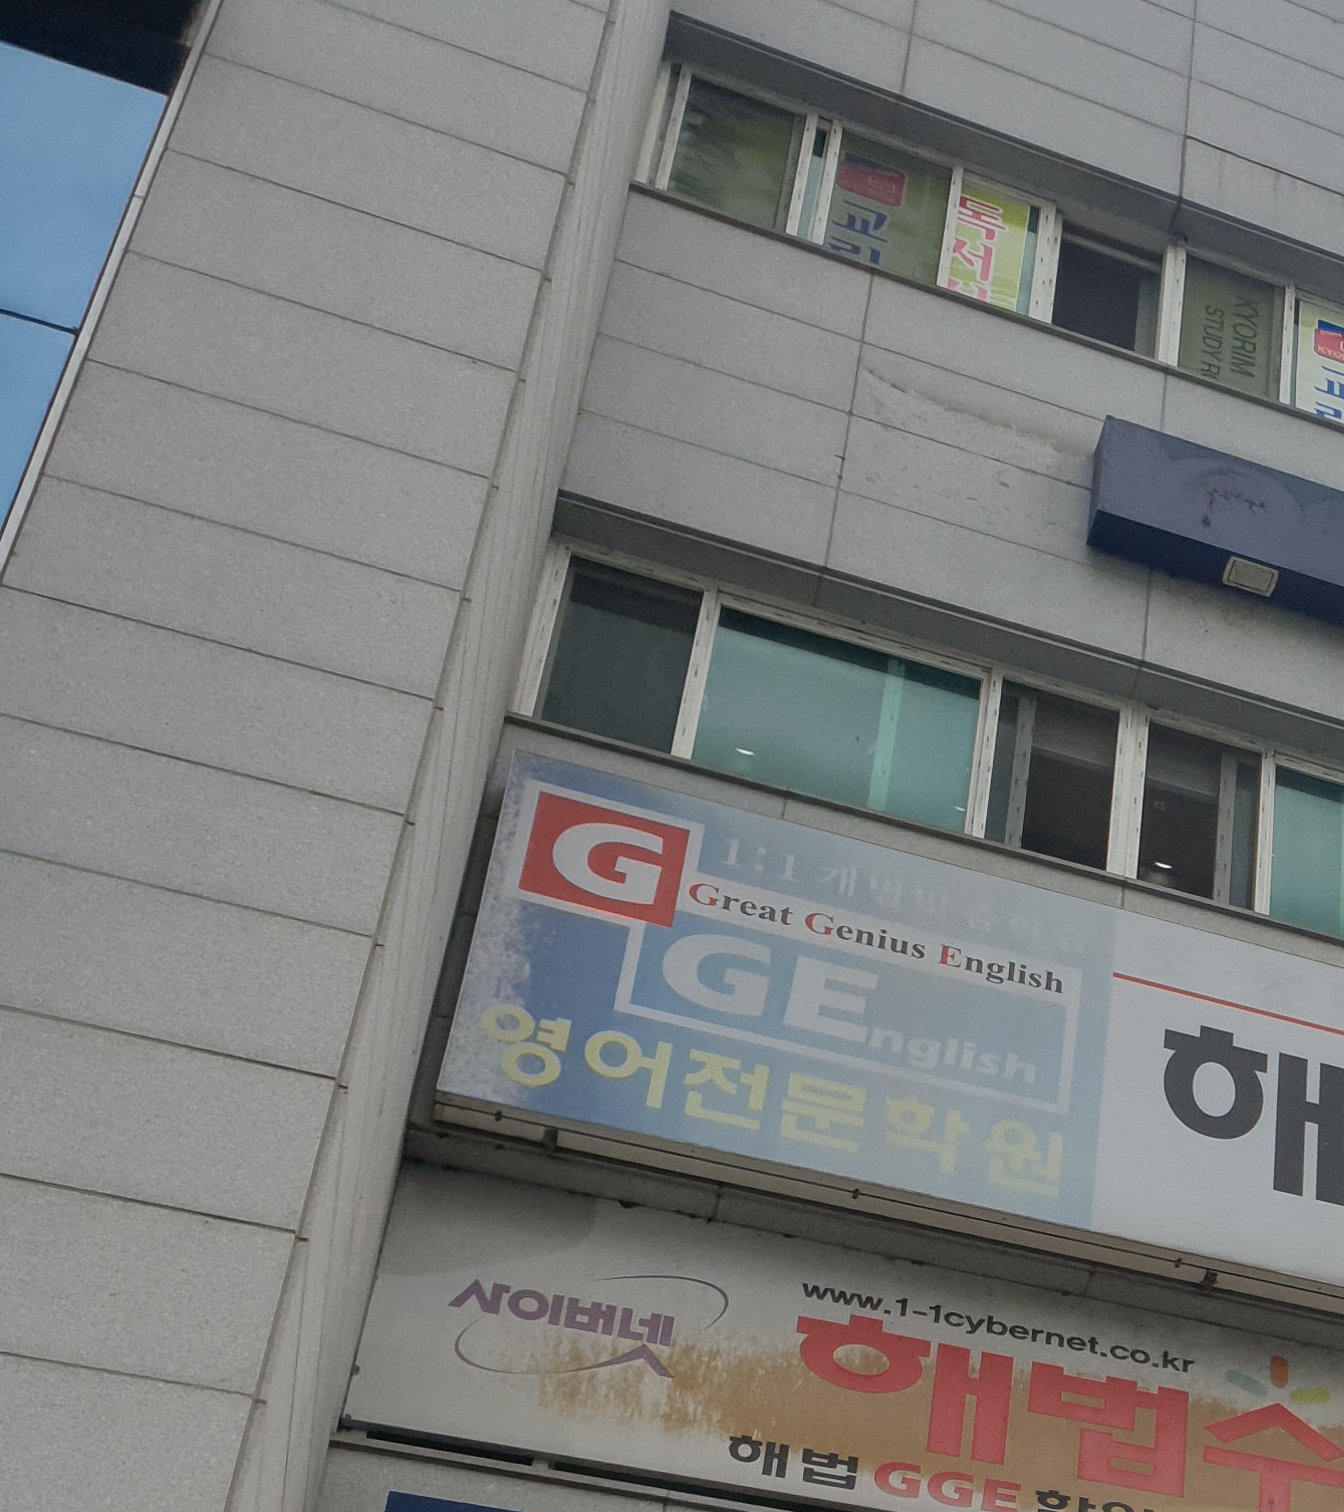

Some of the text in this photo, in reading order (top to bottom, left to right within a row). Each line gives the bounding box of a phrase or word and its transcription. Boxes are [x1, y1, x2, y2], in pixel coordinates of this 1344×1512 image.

[551, 821, 664, 906] G
[688, 880, 794, 928] Great
[803, 910, 927, 963] Genius
[938, 942, 1066, 998] English
[480, 1004, 1065, 1198] 영어전문학원
[800, 1281, 1196, 1375] www.1-1cybernet.co.kr
[727, 1433, 861, 1492] 해법
